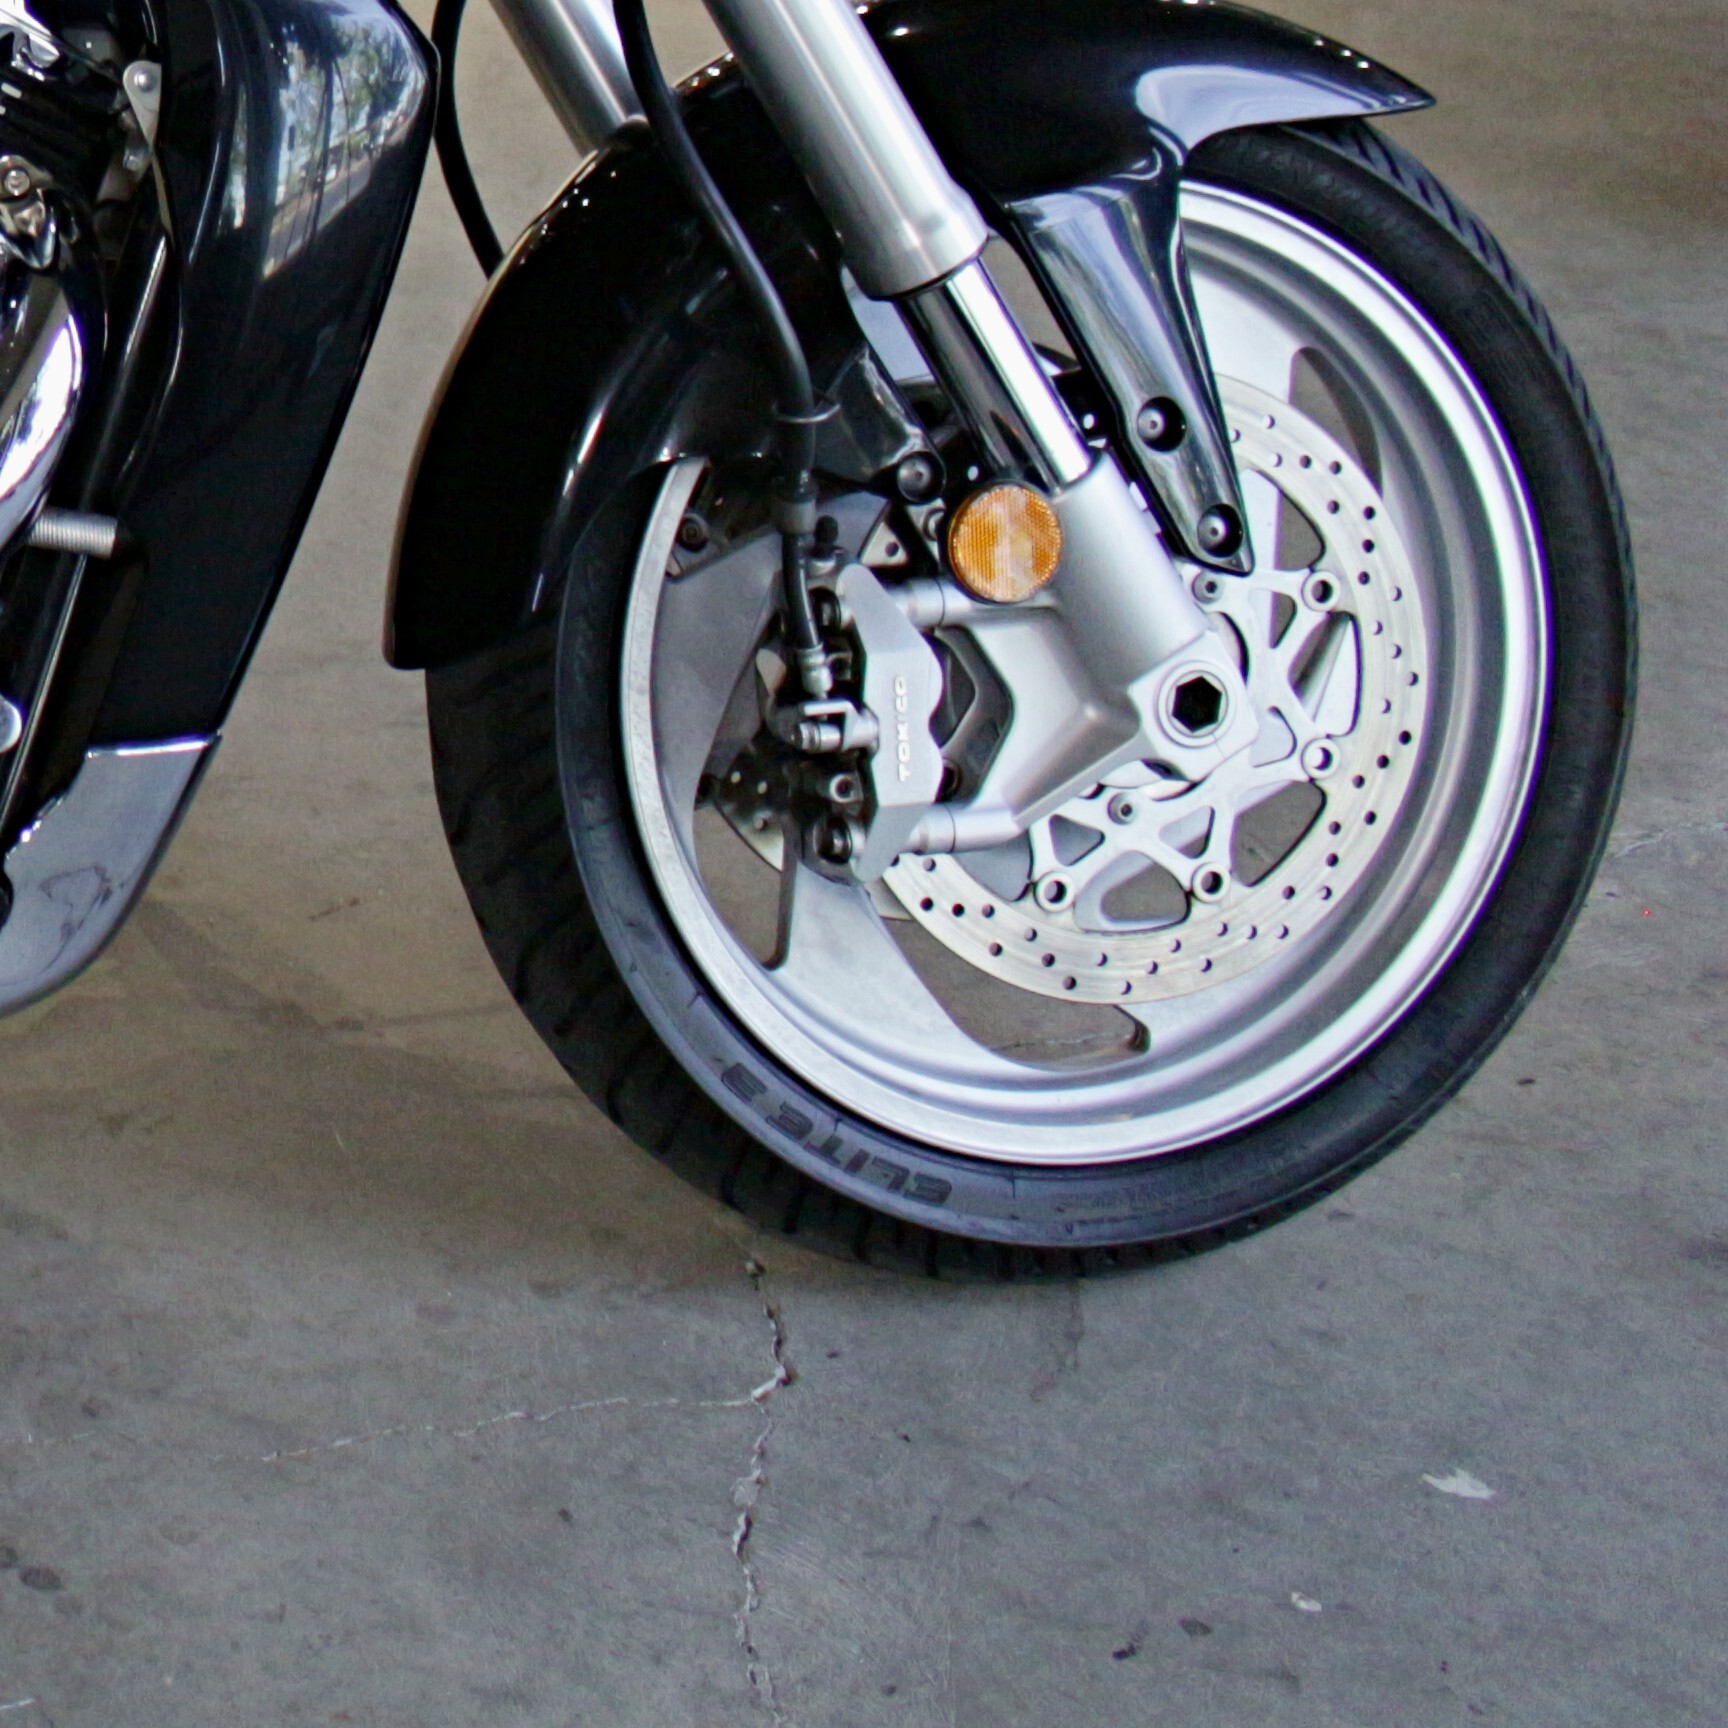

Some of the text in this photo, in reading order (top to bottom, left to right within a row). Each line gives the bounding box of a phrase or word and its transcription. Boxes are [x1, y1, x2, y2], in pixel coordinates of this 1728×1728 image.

[894, 674, 912, 783] TOKICO
[720, 1062, 954, 1207] ELITE 3
